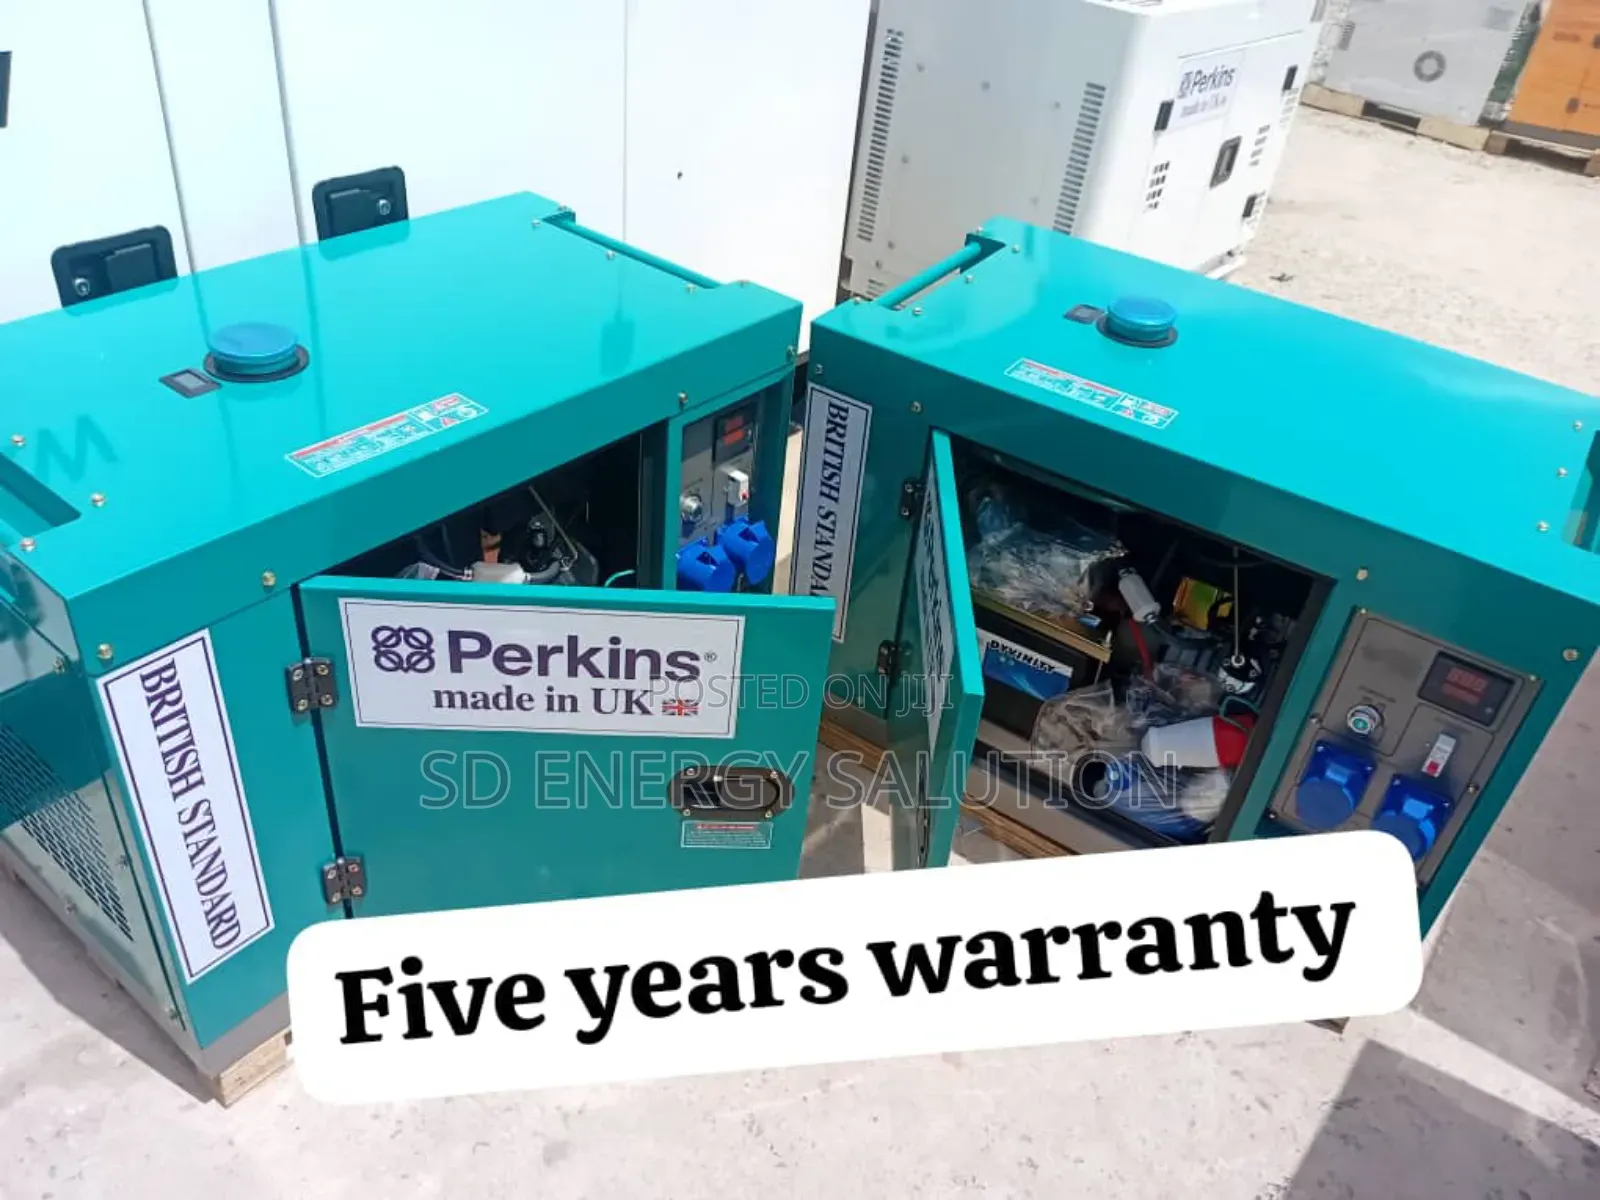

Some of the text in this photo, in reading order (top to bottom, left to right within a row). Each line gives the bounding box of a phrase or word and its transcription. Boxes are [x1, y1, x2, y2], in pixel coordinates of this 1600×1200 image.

[808, 400, 850, 597] BRITISH STANDA
[432, 684, 654, 716] made in UK
[446, 629, 701, 682] Perkins
[139, 657, 243, 951] BRITISH STANDARD
